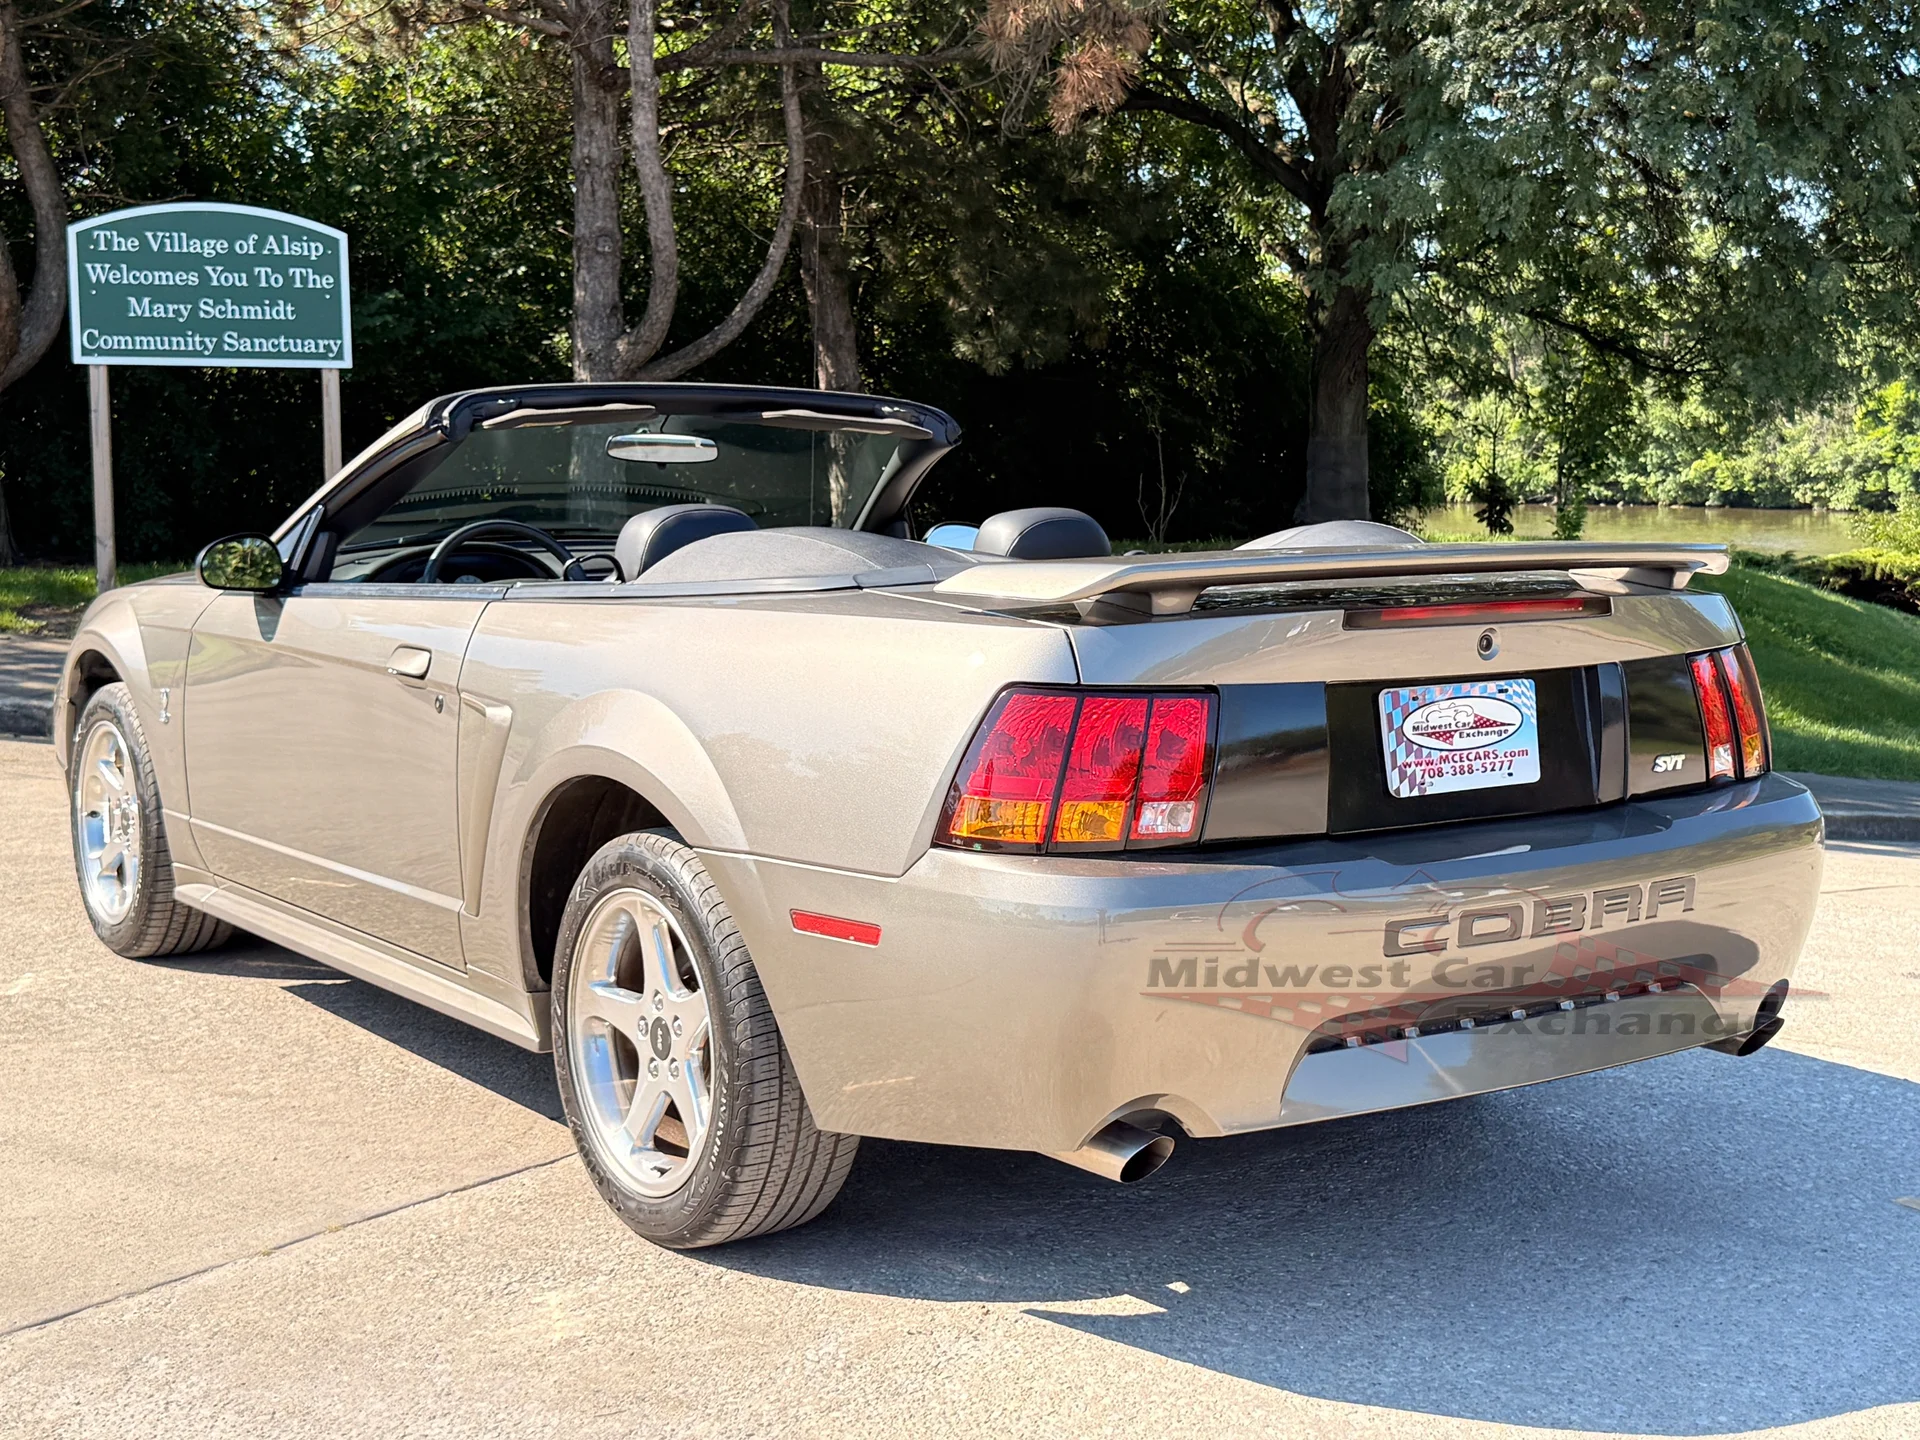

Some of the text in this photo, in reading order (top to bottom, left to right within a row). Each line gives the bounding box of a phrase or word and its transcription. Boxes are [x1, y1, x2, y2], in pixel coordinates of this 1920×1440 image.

[93, 231, 324, 260] The Village of Alsip
[86, 263, 335, 289] Welcomes You To The
[128, 297, 297, 322] Mary Schmidt
[82, 329, 342, 357] Community Sanctuary
[1412, 721, 1471, 733] Midwest Car
[1459, 728, 1509, 739] Exchange
[1402, 749, 1529, 769] www.MCECARS.com
[1420, 759, 1514, 780] 708-388-5277
[1652, 753, 1685, 773] SVT
[1383, 874, 1697, 957] COBRA
